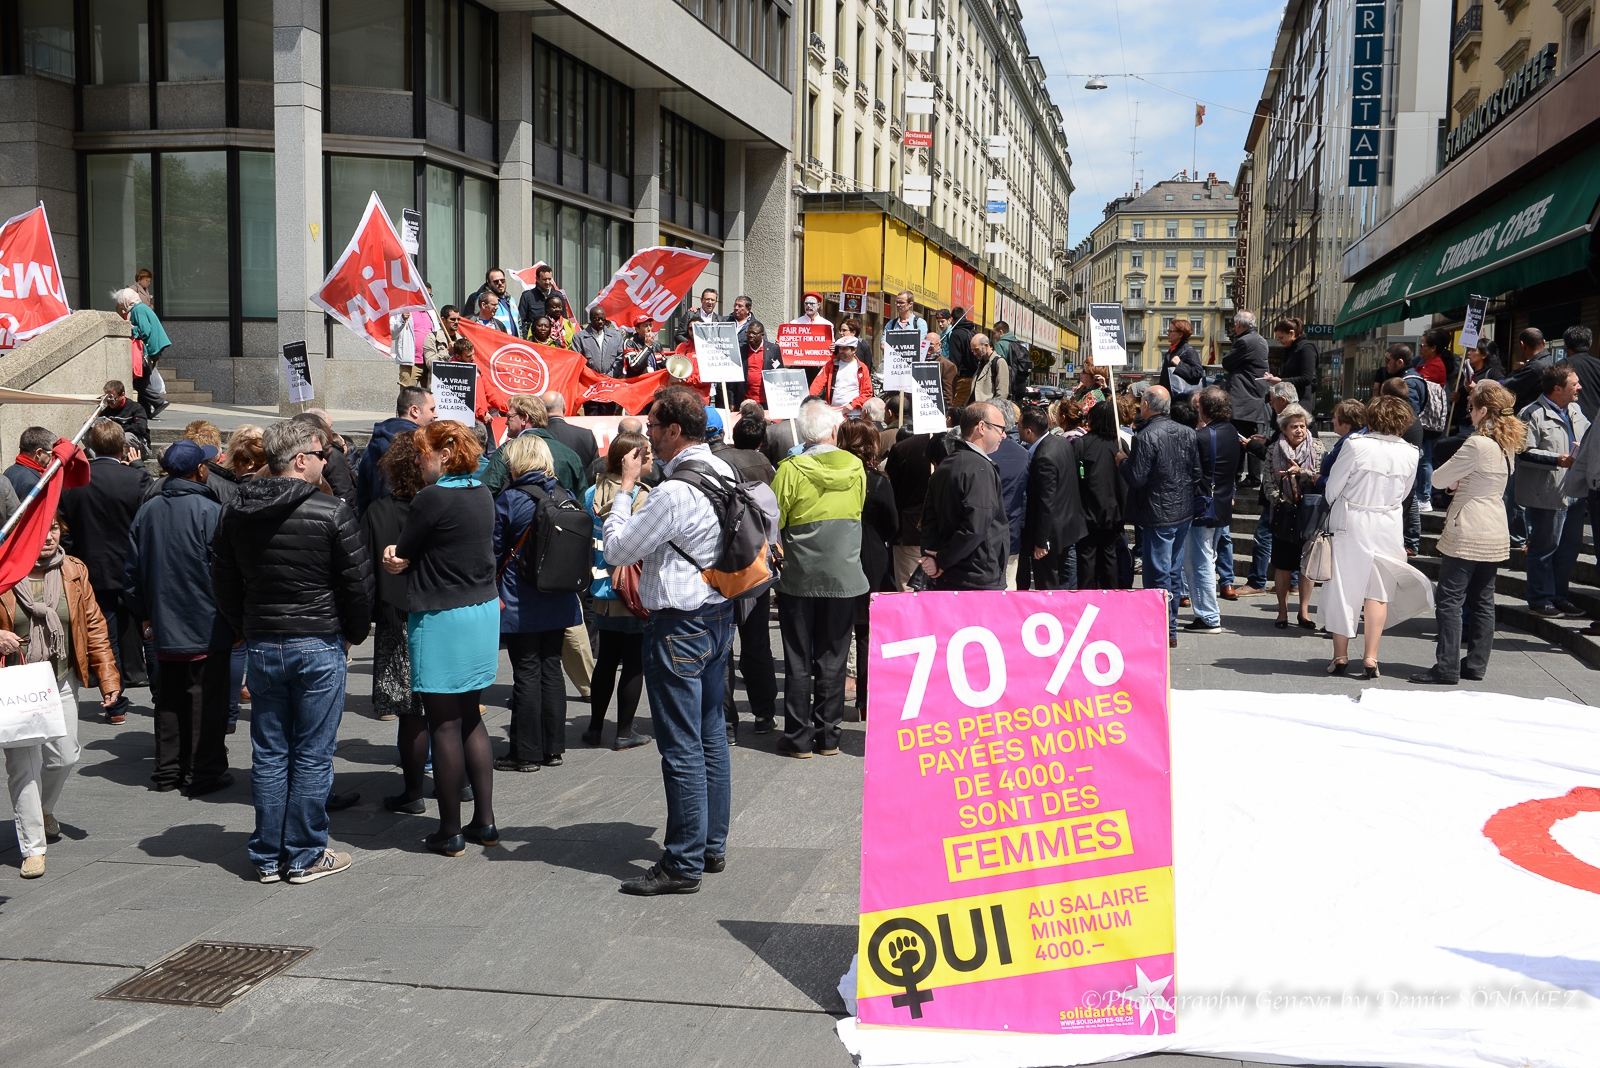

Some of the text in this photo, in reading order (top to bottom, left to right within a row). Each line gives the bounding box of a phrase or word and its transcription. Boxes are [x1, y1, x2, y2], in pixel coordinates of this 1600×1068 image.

[1355, 10, 1376, 182] RISTAL
[1445, 43, 1558, 162] STARBUCKS COFFEE
[1240, 184, 1249, 230] HOTEL
[1436, 193, 1554, 276] STARBUCKS COFFEE
[880, 603, 1124, 721] 70 %
[896, 690, 1132, 751] DES PERSONNES
[918, 720, 1126, 776] PAYÉES MOINS
[954, 774, 993, 800] DE
[958, 784, 1100, 829] SONT DES
[952, 819, 1122, 873] FEMMES
[1028, 886, 1149, 920] AU SALAIRE
[1031, 910, 1132, 940] MINIMUM
